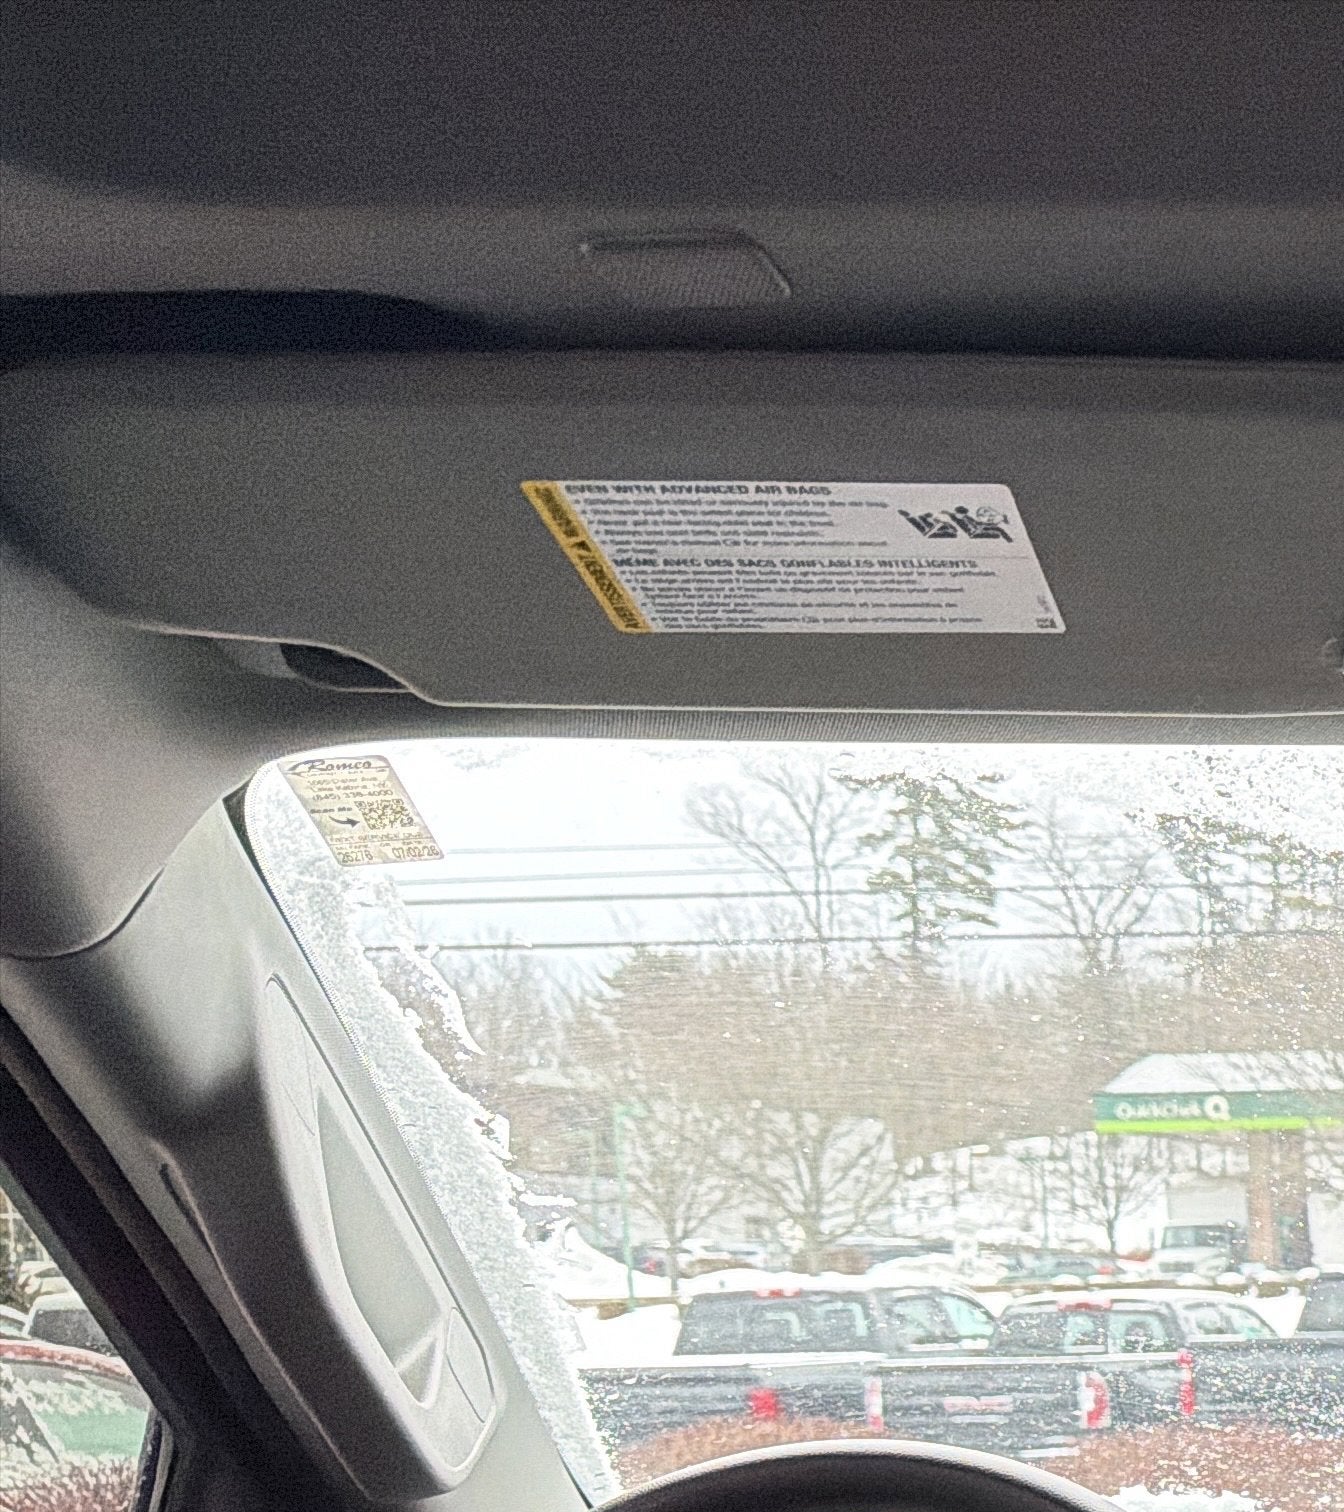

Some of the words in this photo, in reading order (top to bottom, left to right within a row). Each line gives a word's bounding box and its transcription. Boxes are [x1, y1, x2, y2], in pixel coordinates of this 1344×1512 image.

[565, 484, 609, 495] EVEN
[613, 484, 656, 495] WITH
[661, 485, 749, 495] ADVANCED
[755, 485, 782, 495] AIR
[787, 485, 832, 496] BAGS
[663, 558, 702, 567] AVEC
[704, 559, 734, 567] DES
[738, 559, 776, 567] SACS
